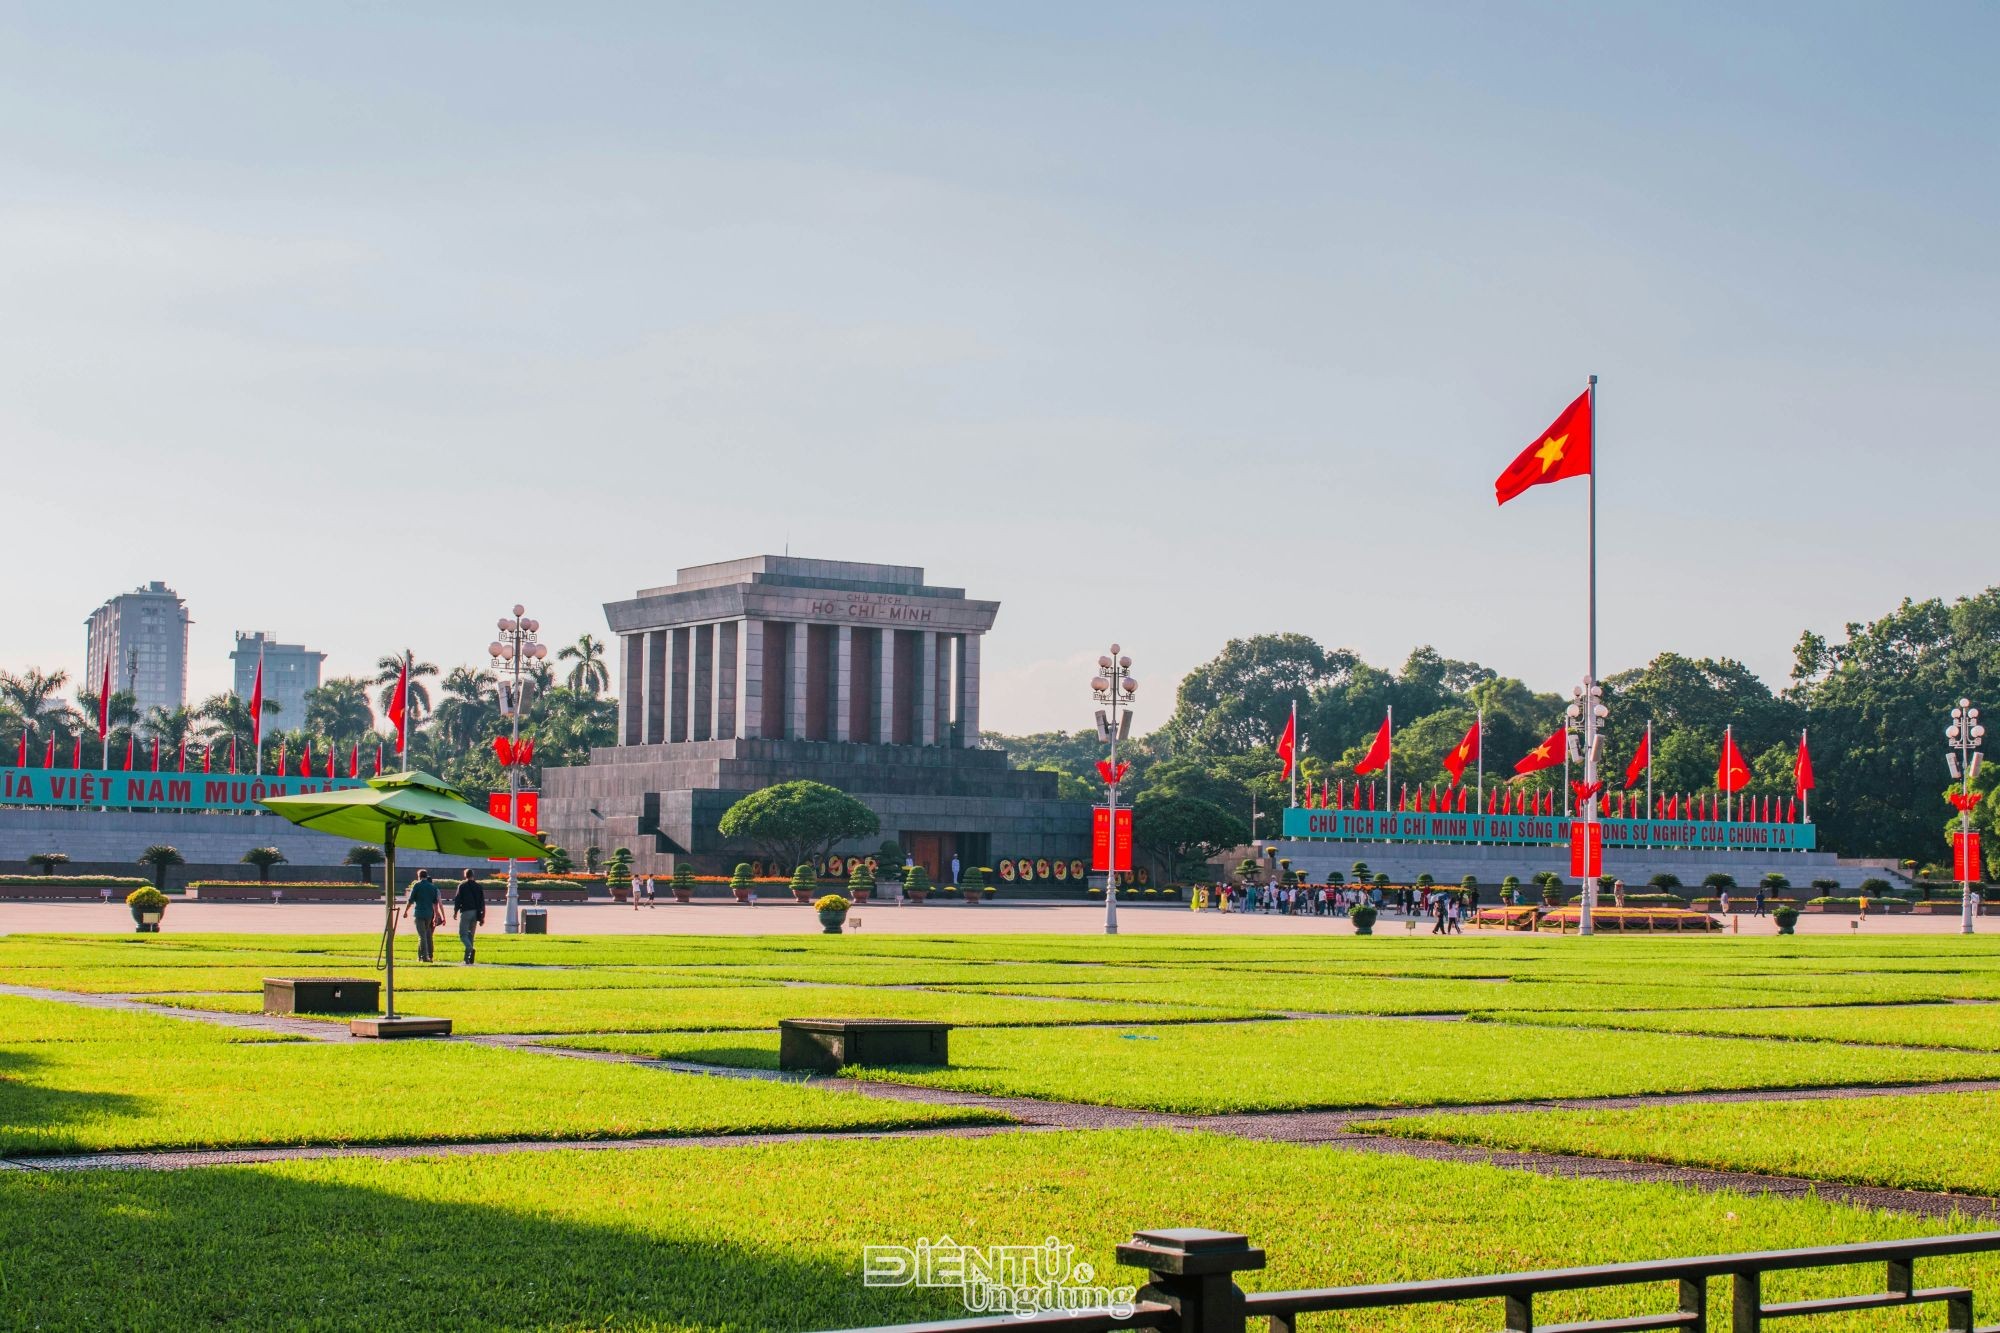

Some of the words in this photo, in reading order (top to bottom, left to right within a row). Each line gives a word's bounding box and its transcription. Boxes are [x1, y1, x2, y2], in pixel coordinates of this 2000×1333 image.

[0, 770, 34, 798] ĨA
[50, 773, 113, 804] VIỆT
[127, 778, 191, 803] NAM
[205, 778, 287, 803] MUÔN
[1309, 810, 1337, 832] CHỦ
[1343, 816, 1374, 837] TỊCH
[1380, 812, 1398, 835] HỒ
[1403, 814, 1426, 836] CHÍ
[1431, 818, 1467, 837] MINH
[1473, 817, 1485, 837] VĨ
[1490, 820, 1513, 840] ĐẠI
[1518, 816, 1552, 839] SỐNG
[1602, 823, 1628, 841] ONG
[1632, 822, 1650, 844] SỰ
[1653, 822, 1697, 845] NGHIỆP
[1701, 822, 1724, 842] CỦA
[1729, 824, 1768, 843] CHÚNG
[1772, 828, 1786, 844] TA
